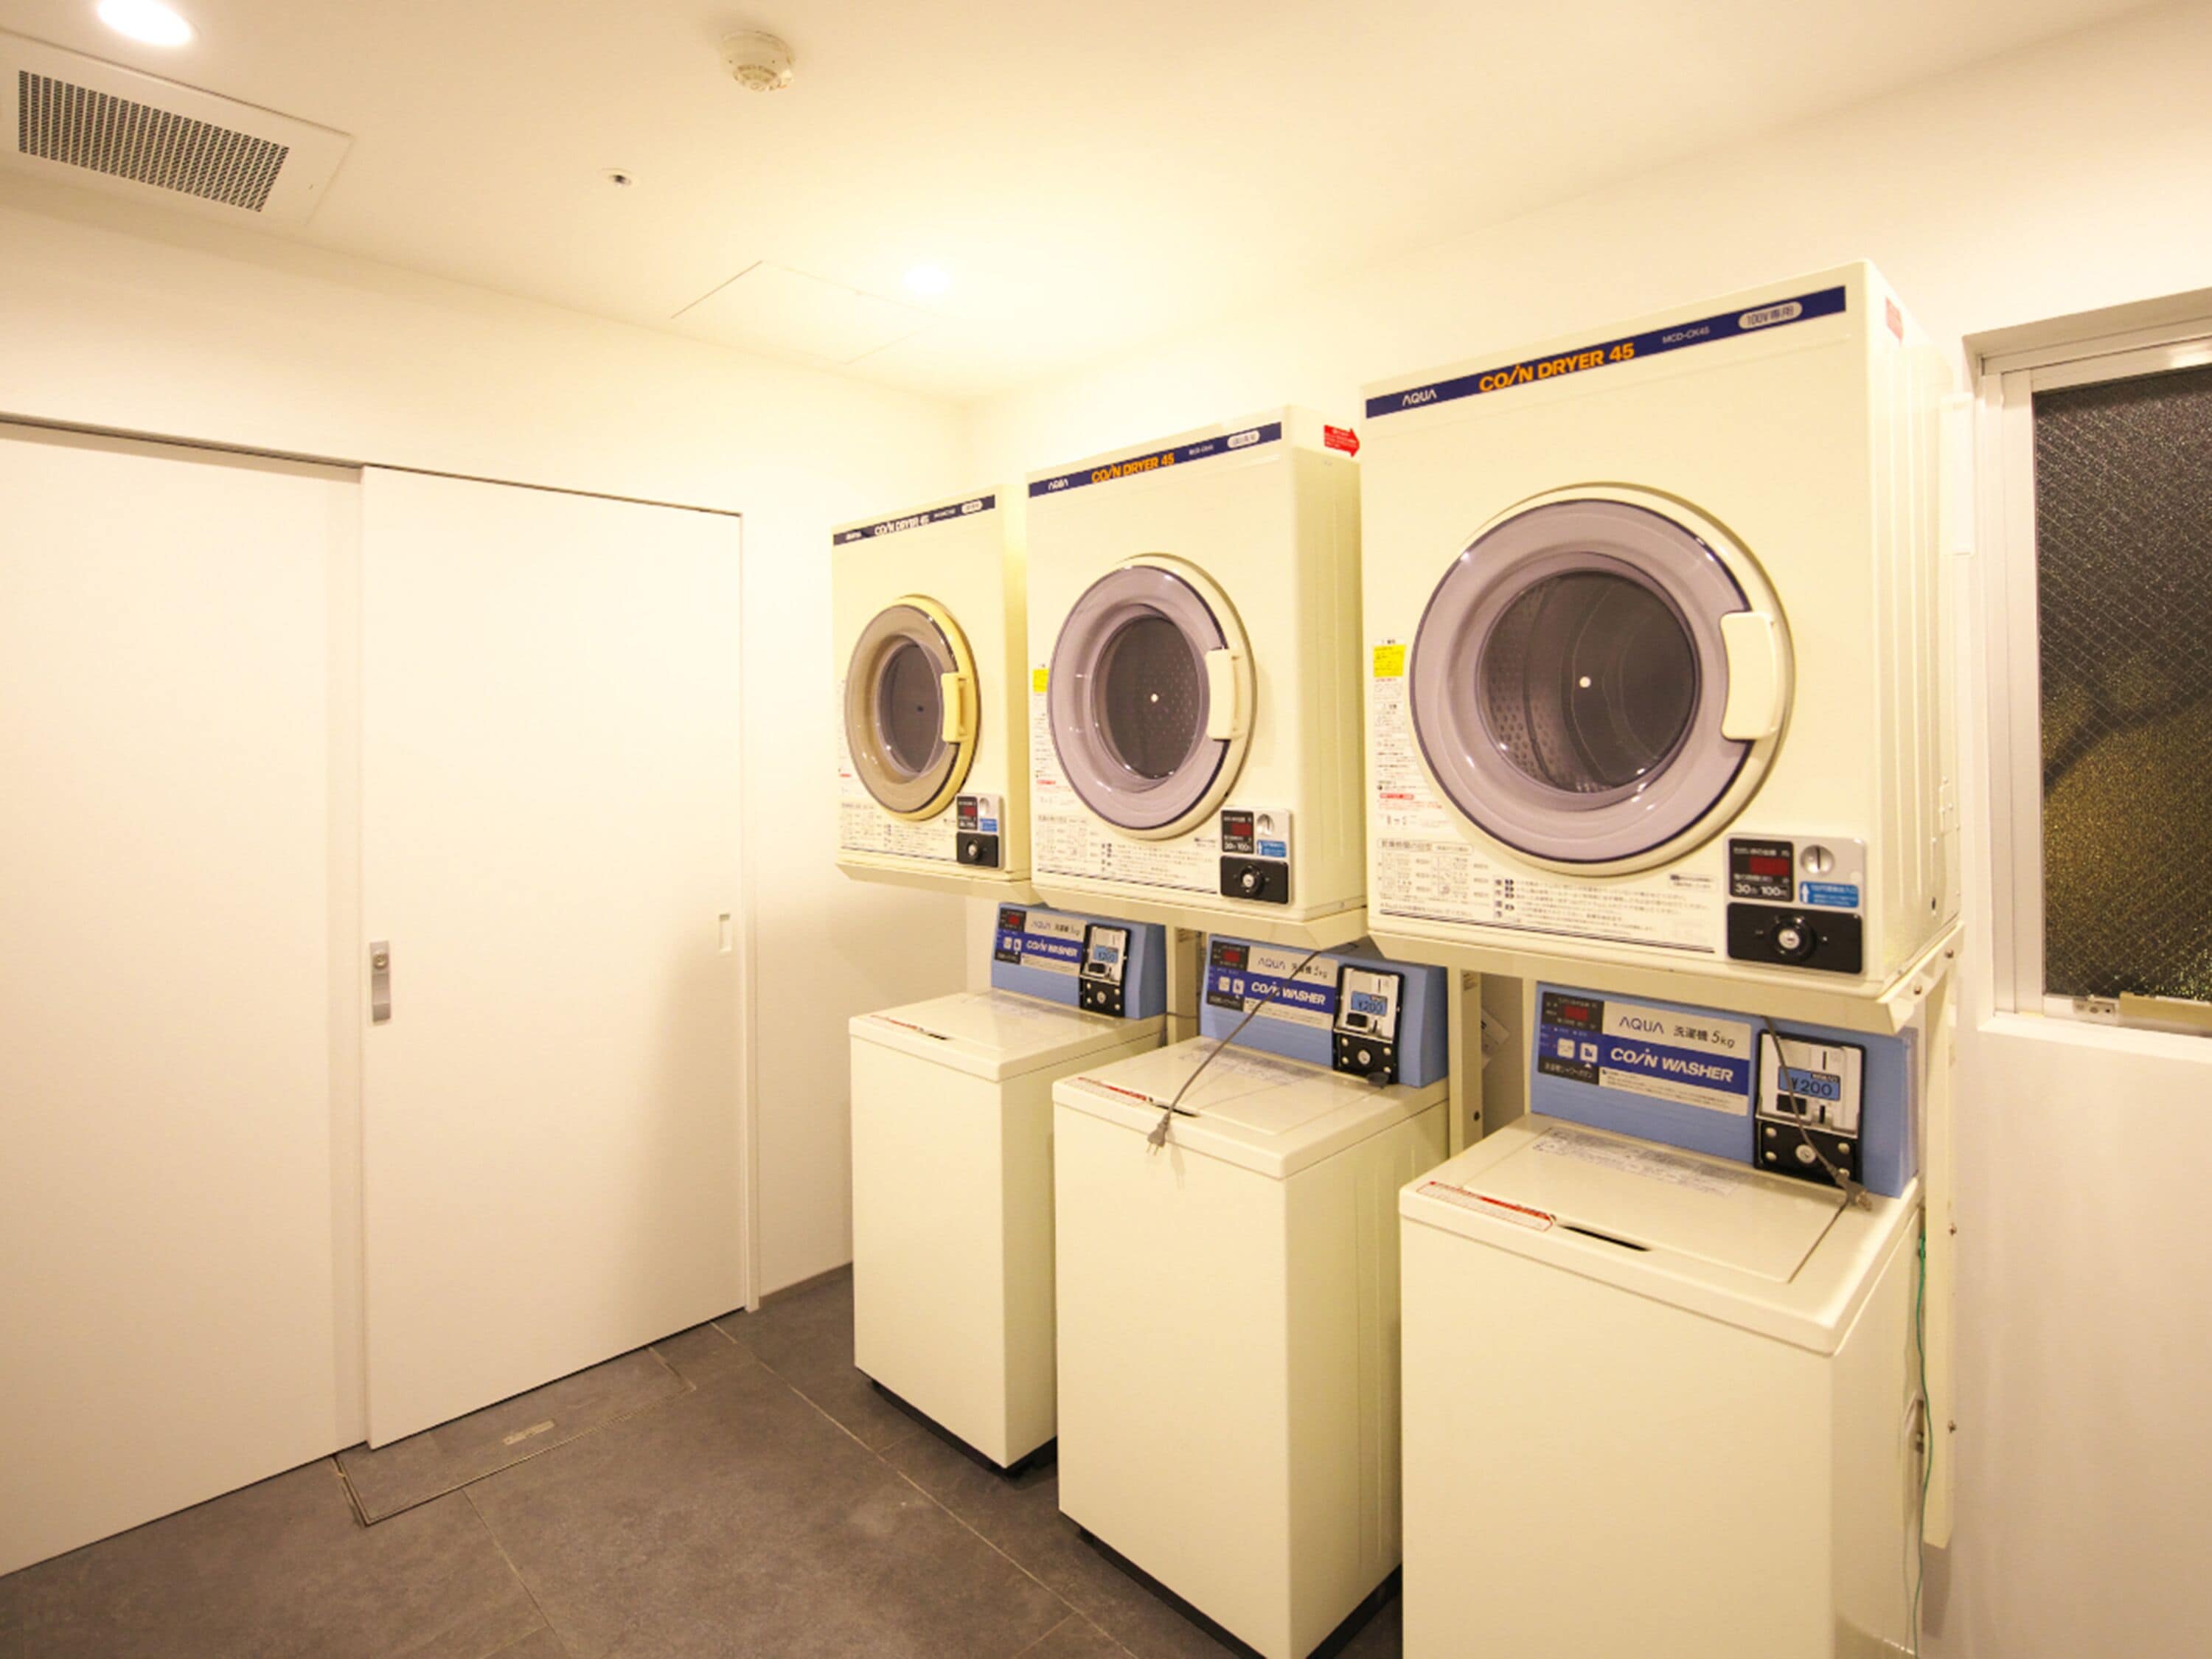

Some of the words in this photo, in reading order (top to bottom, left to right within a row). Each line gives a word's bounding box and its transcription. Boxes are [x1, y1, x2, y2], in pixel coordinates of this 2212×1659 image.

[1537, 349, 1605, 379] DRYER
[1608, 341, 1635, 362] 45
[1402, 389, 1437, 406] AQUA
[1122, 456, 1159, 476] DRYER
[1161, 452, 1175, 467] 45
[1282, 984, 1326, 1005] WASHER
[1618, 1016, 1664, 1034] AQUA
[1673, 1025, 1709, 1042] 洗濯機
[1710, 1032, 1736, 1049] 5kg
[1661, 1056, 1734, 1082] WASHER
